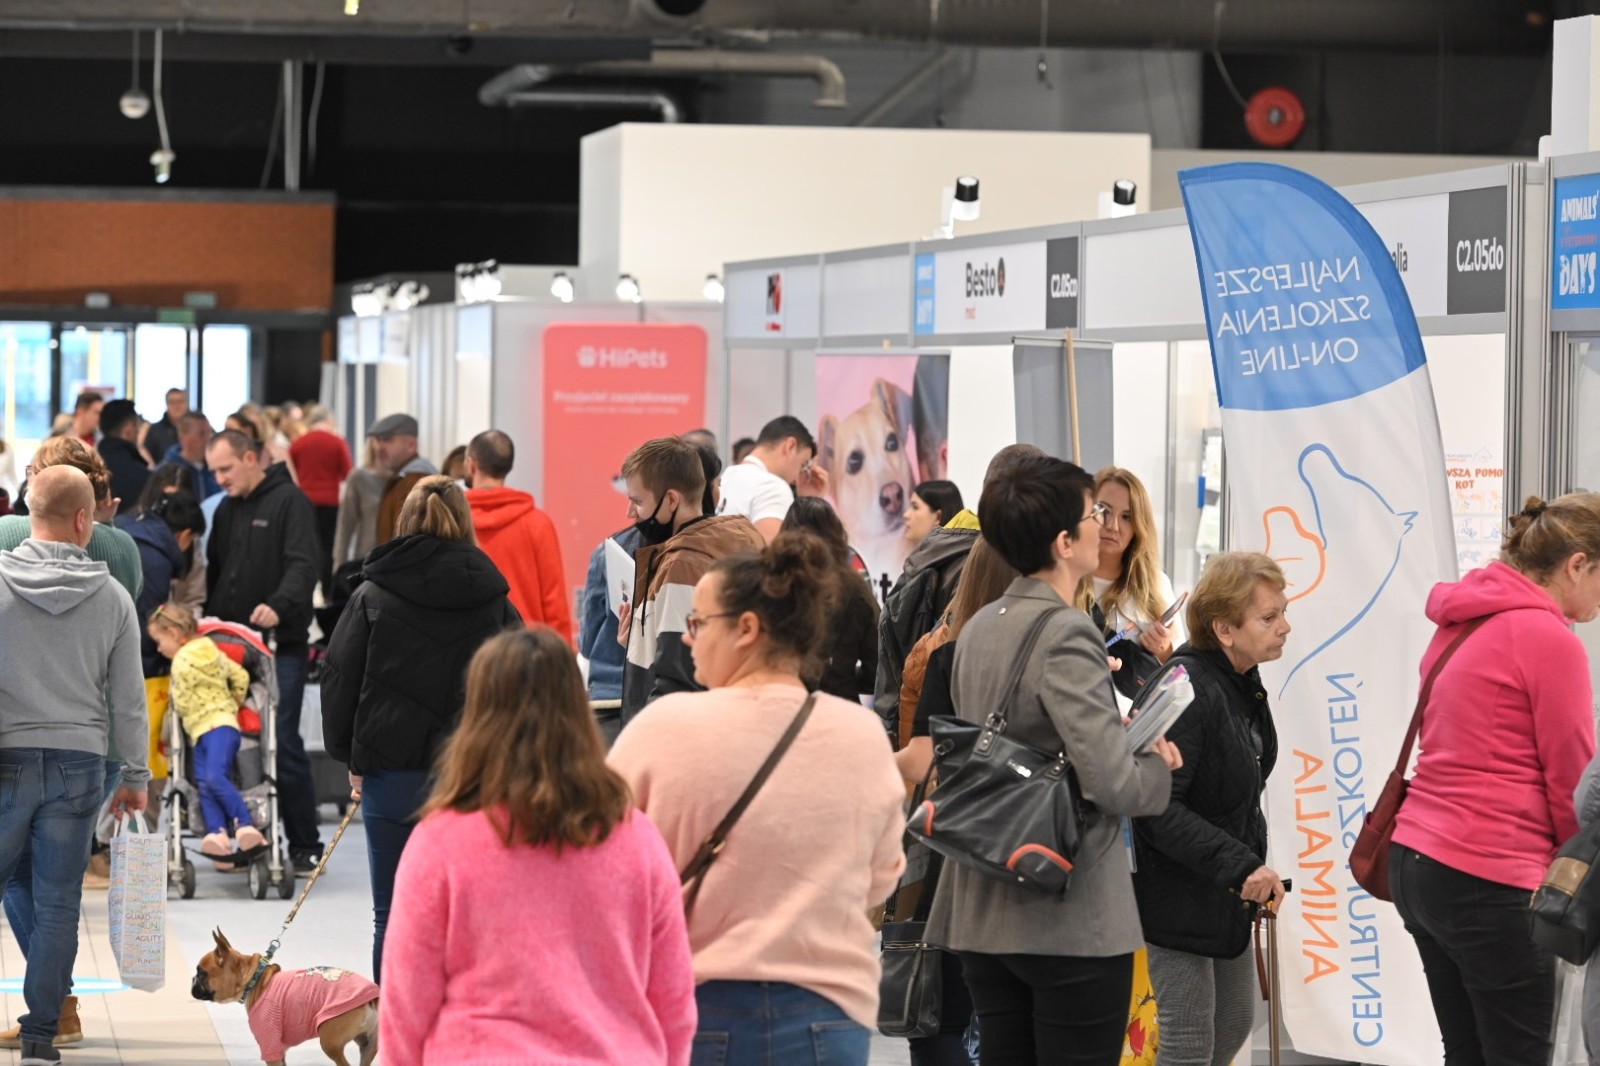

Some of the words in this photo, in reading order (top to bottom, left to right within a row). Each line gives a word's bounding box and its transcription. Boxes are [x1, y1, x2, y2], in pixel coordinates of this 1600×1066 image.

[1456, 237, 1504, 272] C2.05do
[966, 262, 996, 298] Besto
[1560, 251, 1597, 295] DAYS
[599, 347, 668, 368] HiPets
[1455, 480, 1475, 490] KOT
